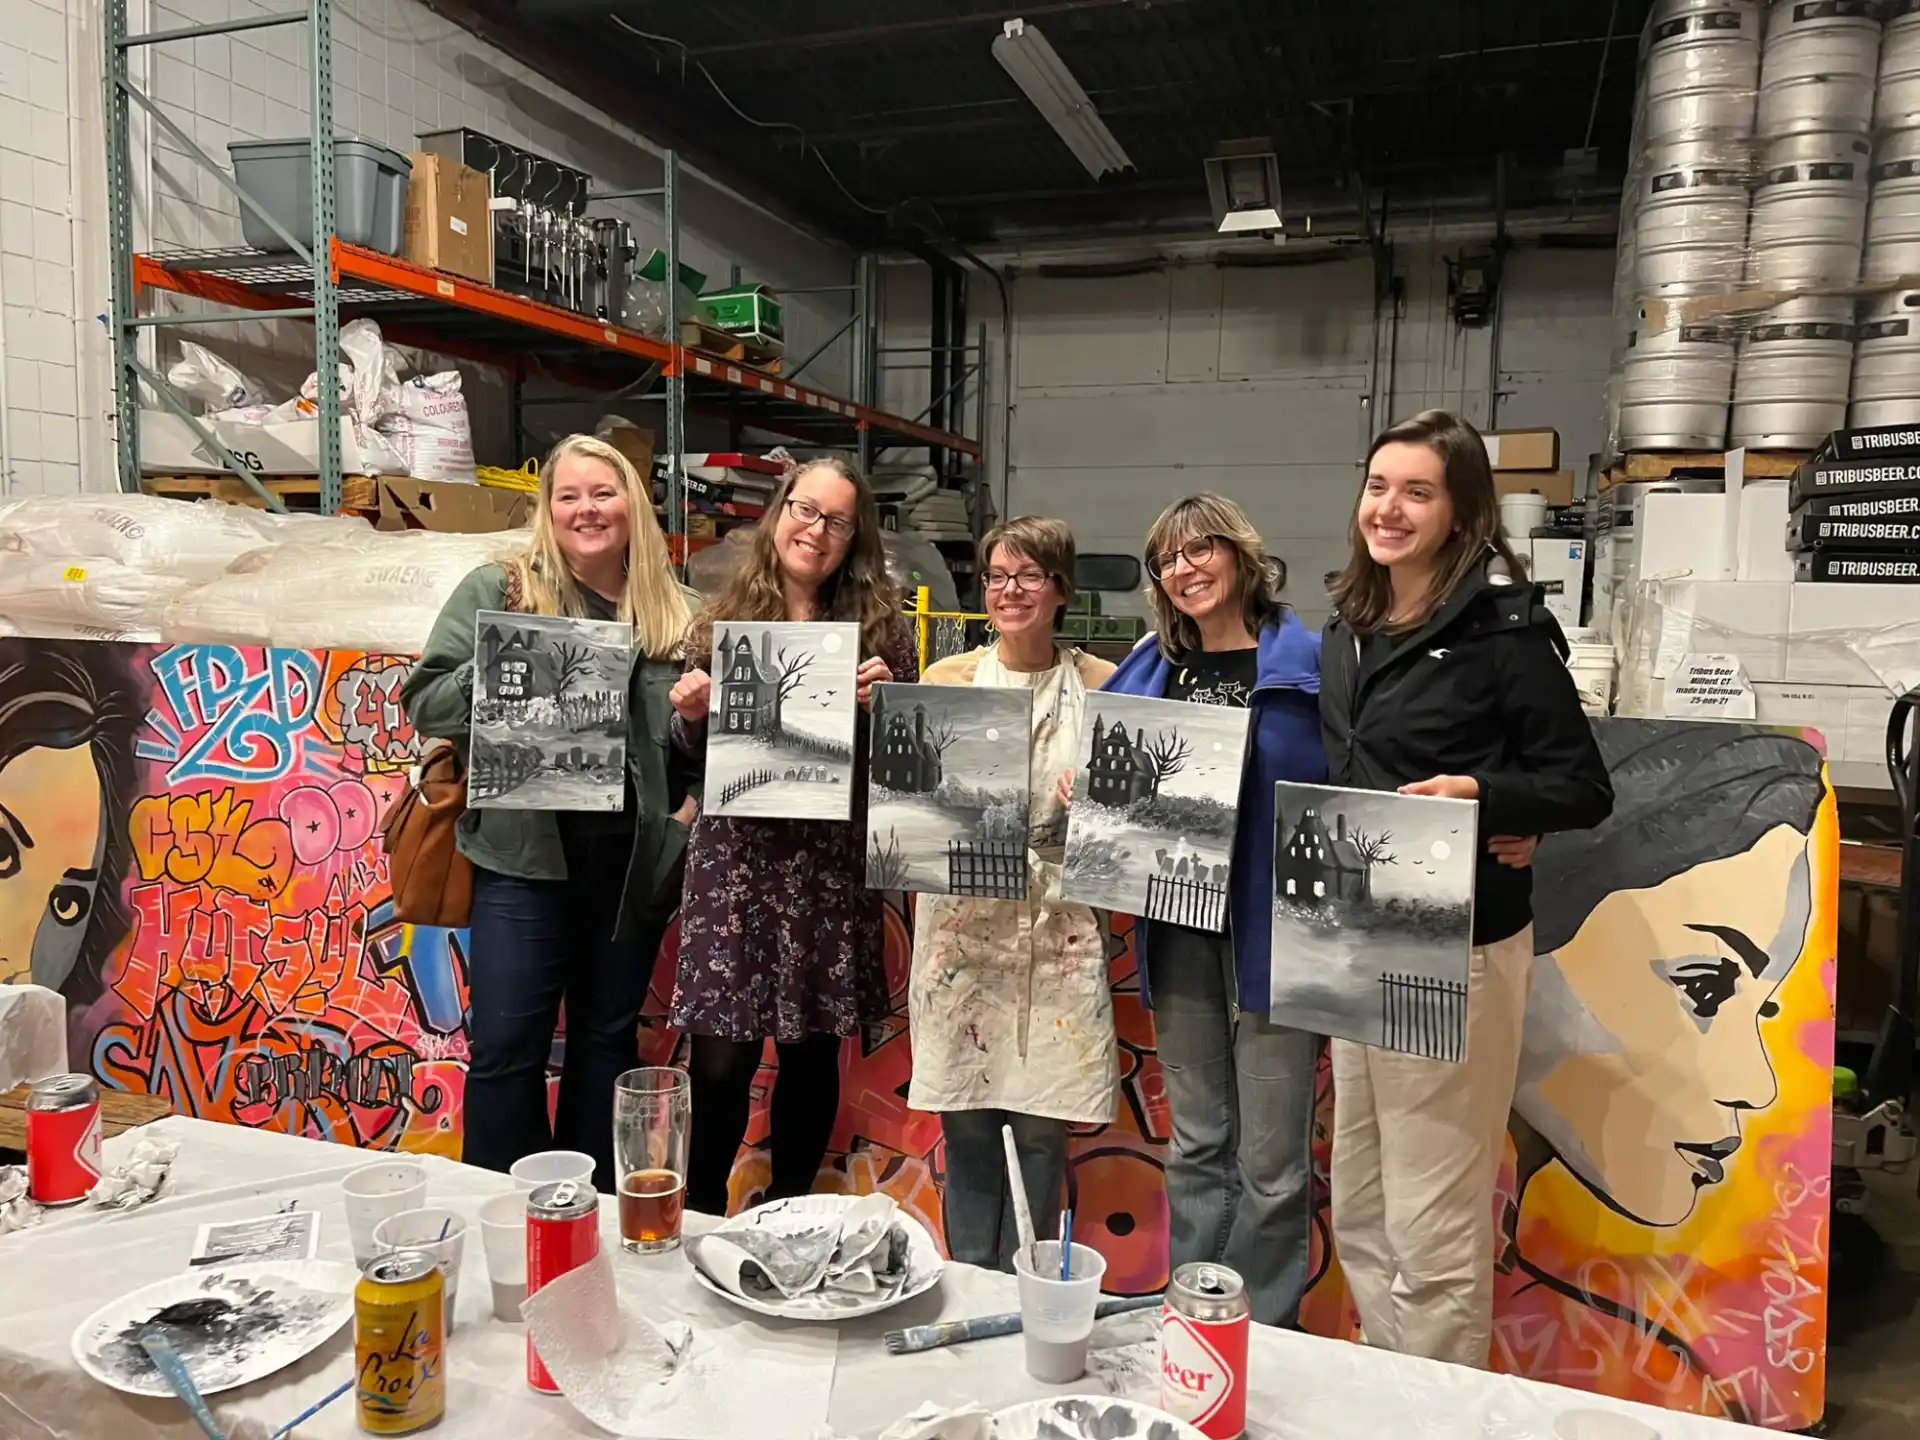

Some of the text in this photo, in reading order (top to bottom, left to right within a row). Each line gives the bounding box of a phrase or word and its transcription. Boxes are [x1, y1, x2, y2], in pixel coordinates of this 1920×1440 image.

[1689, 667, 1734, 676] Tribus Beer
[1707, 687, 1743, 697] Germany
